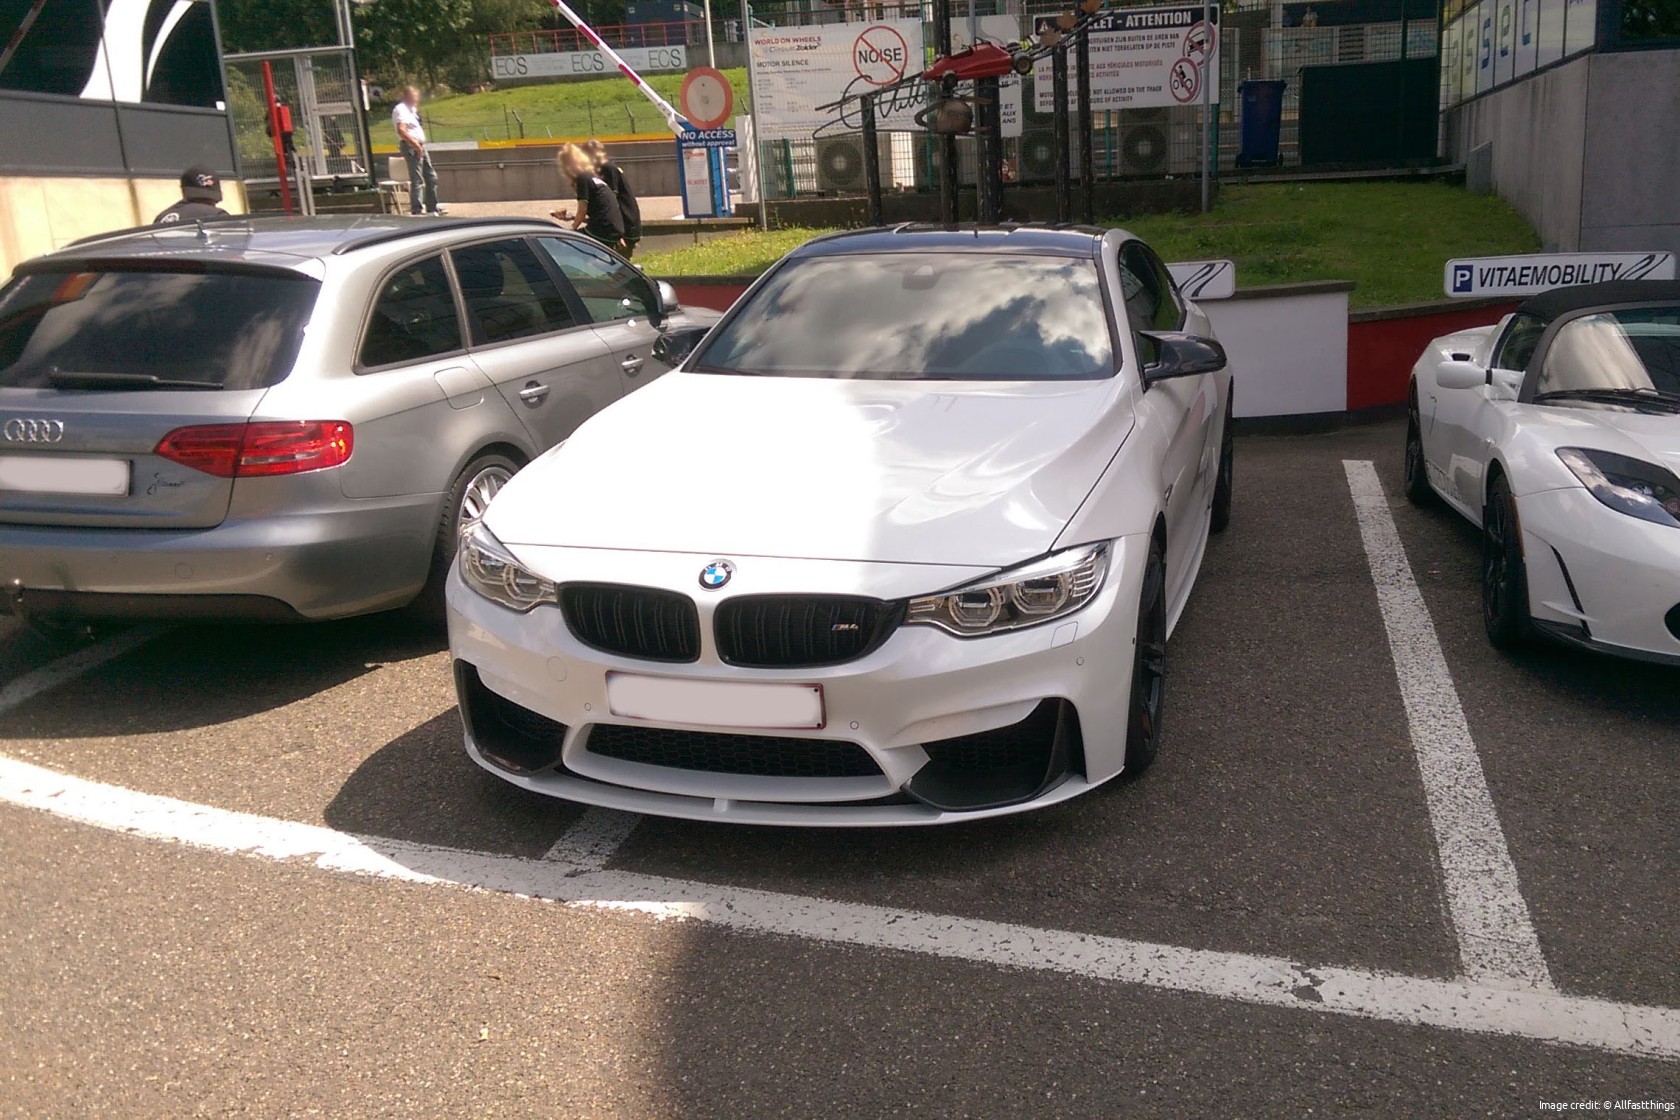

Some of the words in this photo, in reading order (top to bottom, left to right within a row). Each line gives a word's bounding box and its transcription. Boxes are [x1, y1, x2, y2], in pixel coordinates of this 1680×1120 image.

[1126, 11, 1192, 28] ATTENTION
[571, 53, 604, 72] ECS
[648, 48, 682, 68] ECS
[781, 59, 809, 67] SILENCE
[858, 47, 903, 64] NOISE
[495, 56, 528, 76] ECS
[682, 131, 696, 140] NO
[698, 130, 734, 139] ACCESS
[706, 140, 734, 148] approval
[1456, 269, 1471, 287] P
[1479, 262, 1623, 288] VITAEMOBILITY
